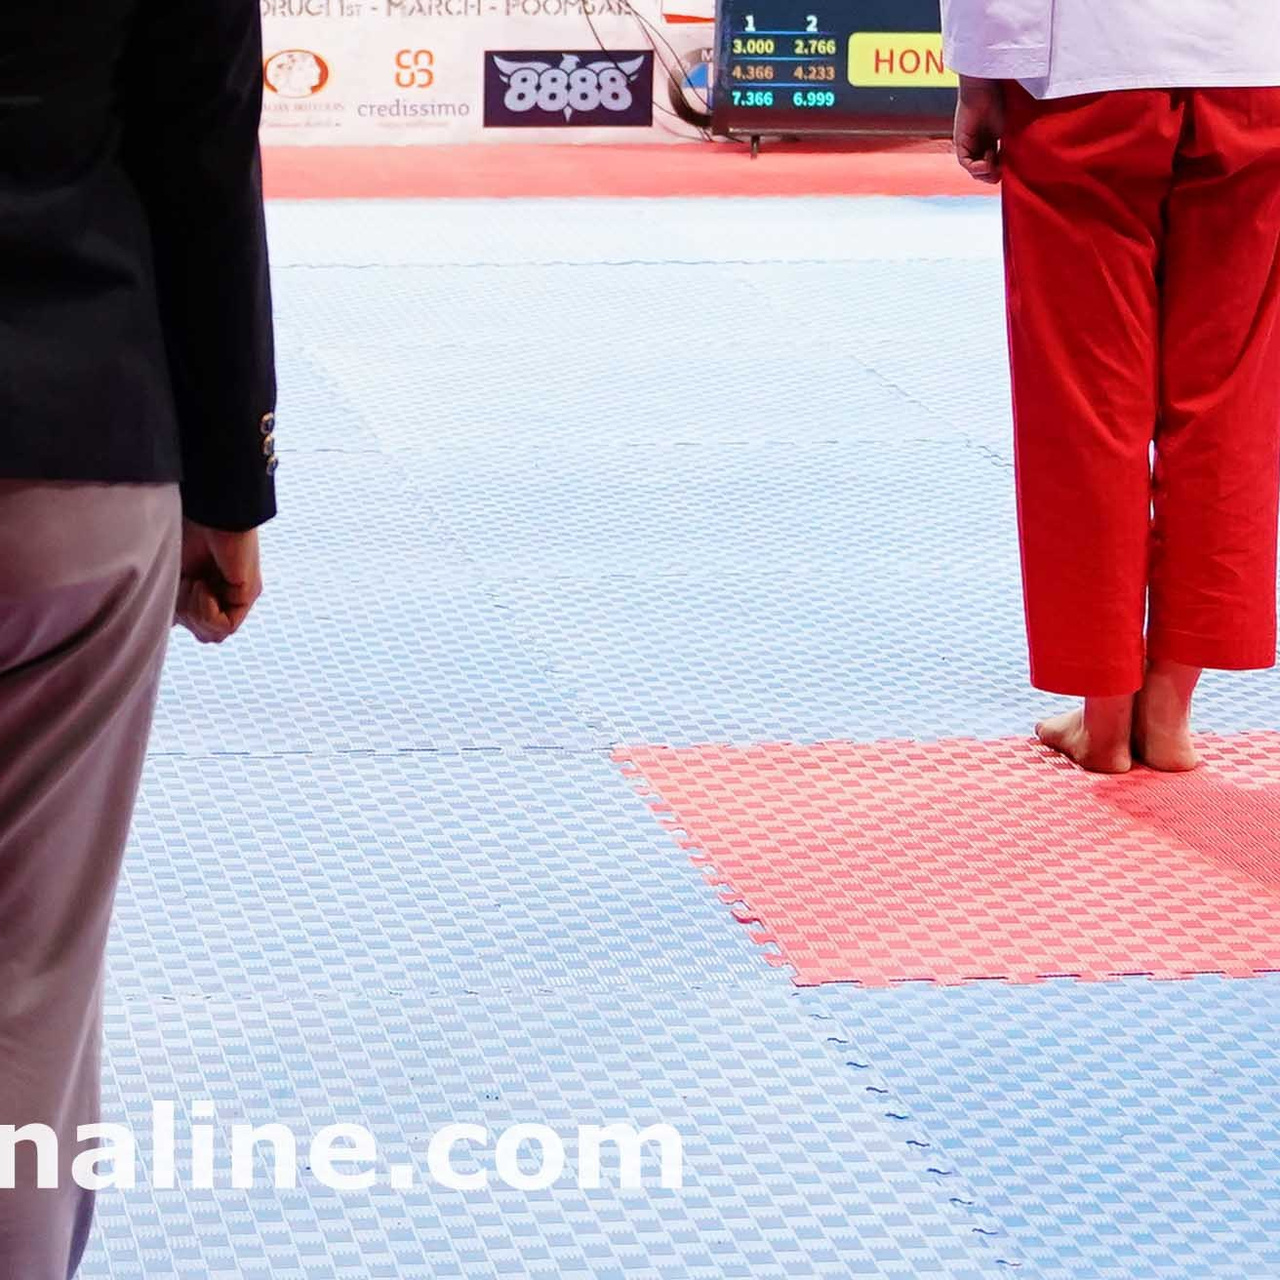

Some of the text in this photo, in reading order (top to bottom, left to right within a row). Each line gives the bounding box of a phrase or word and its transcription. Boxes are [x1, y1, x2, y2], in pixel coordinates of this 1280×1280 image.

[744, 15, 818, 32] 1 2
[732, 39, 836, 55] 3.000 2.766
[731, 65, 836, 81] 4.366 4.233
[504, 68, 633, 113] 8888
[731, 91, 835, 107] 7.366 6.999
[357, 99, 469, 118] credissimo
